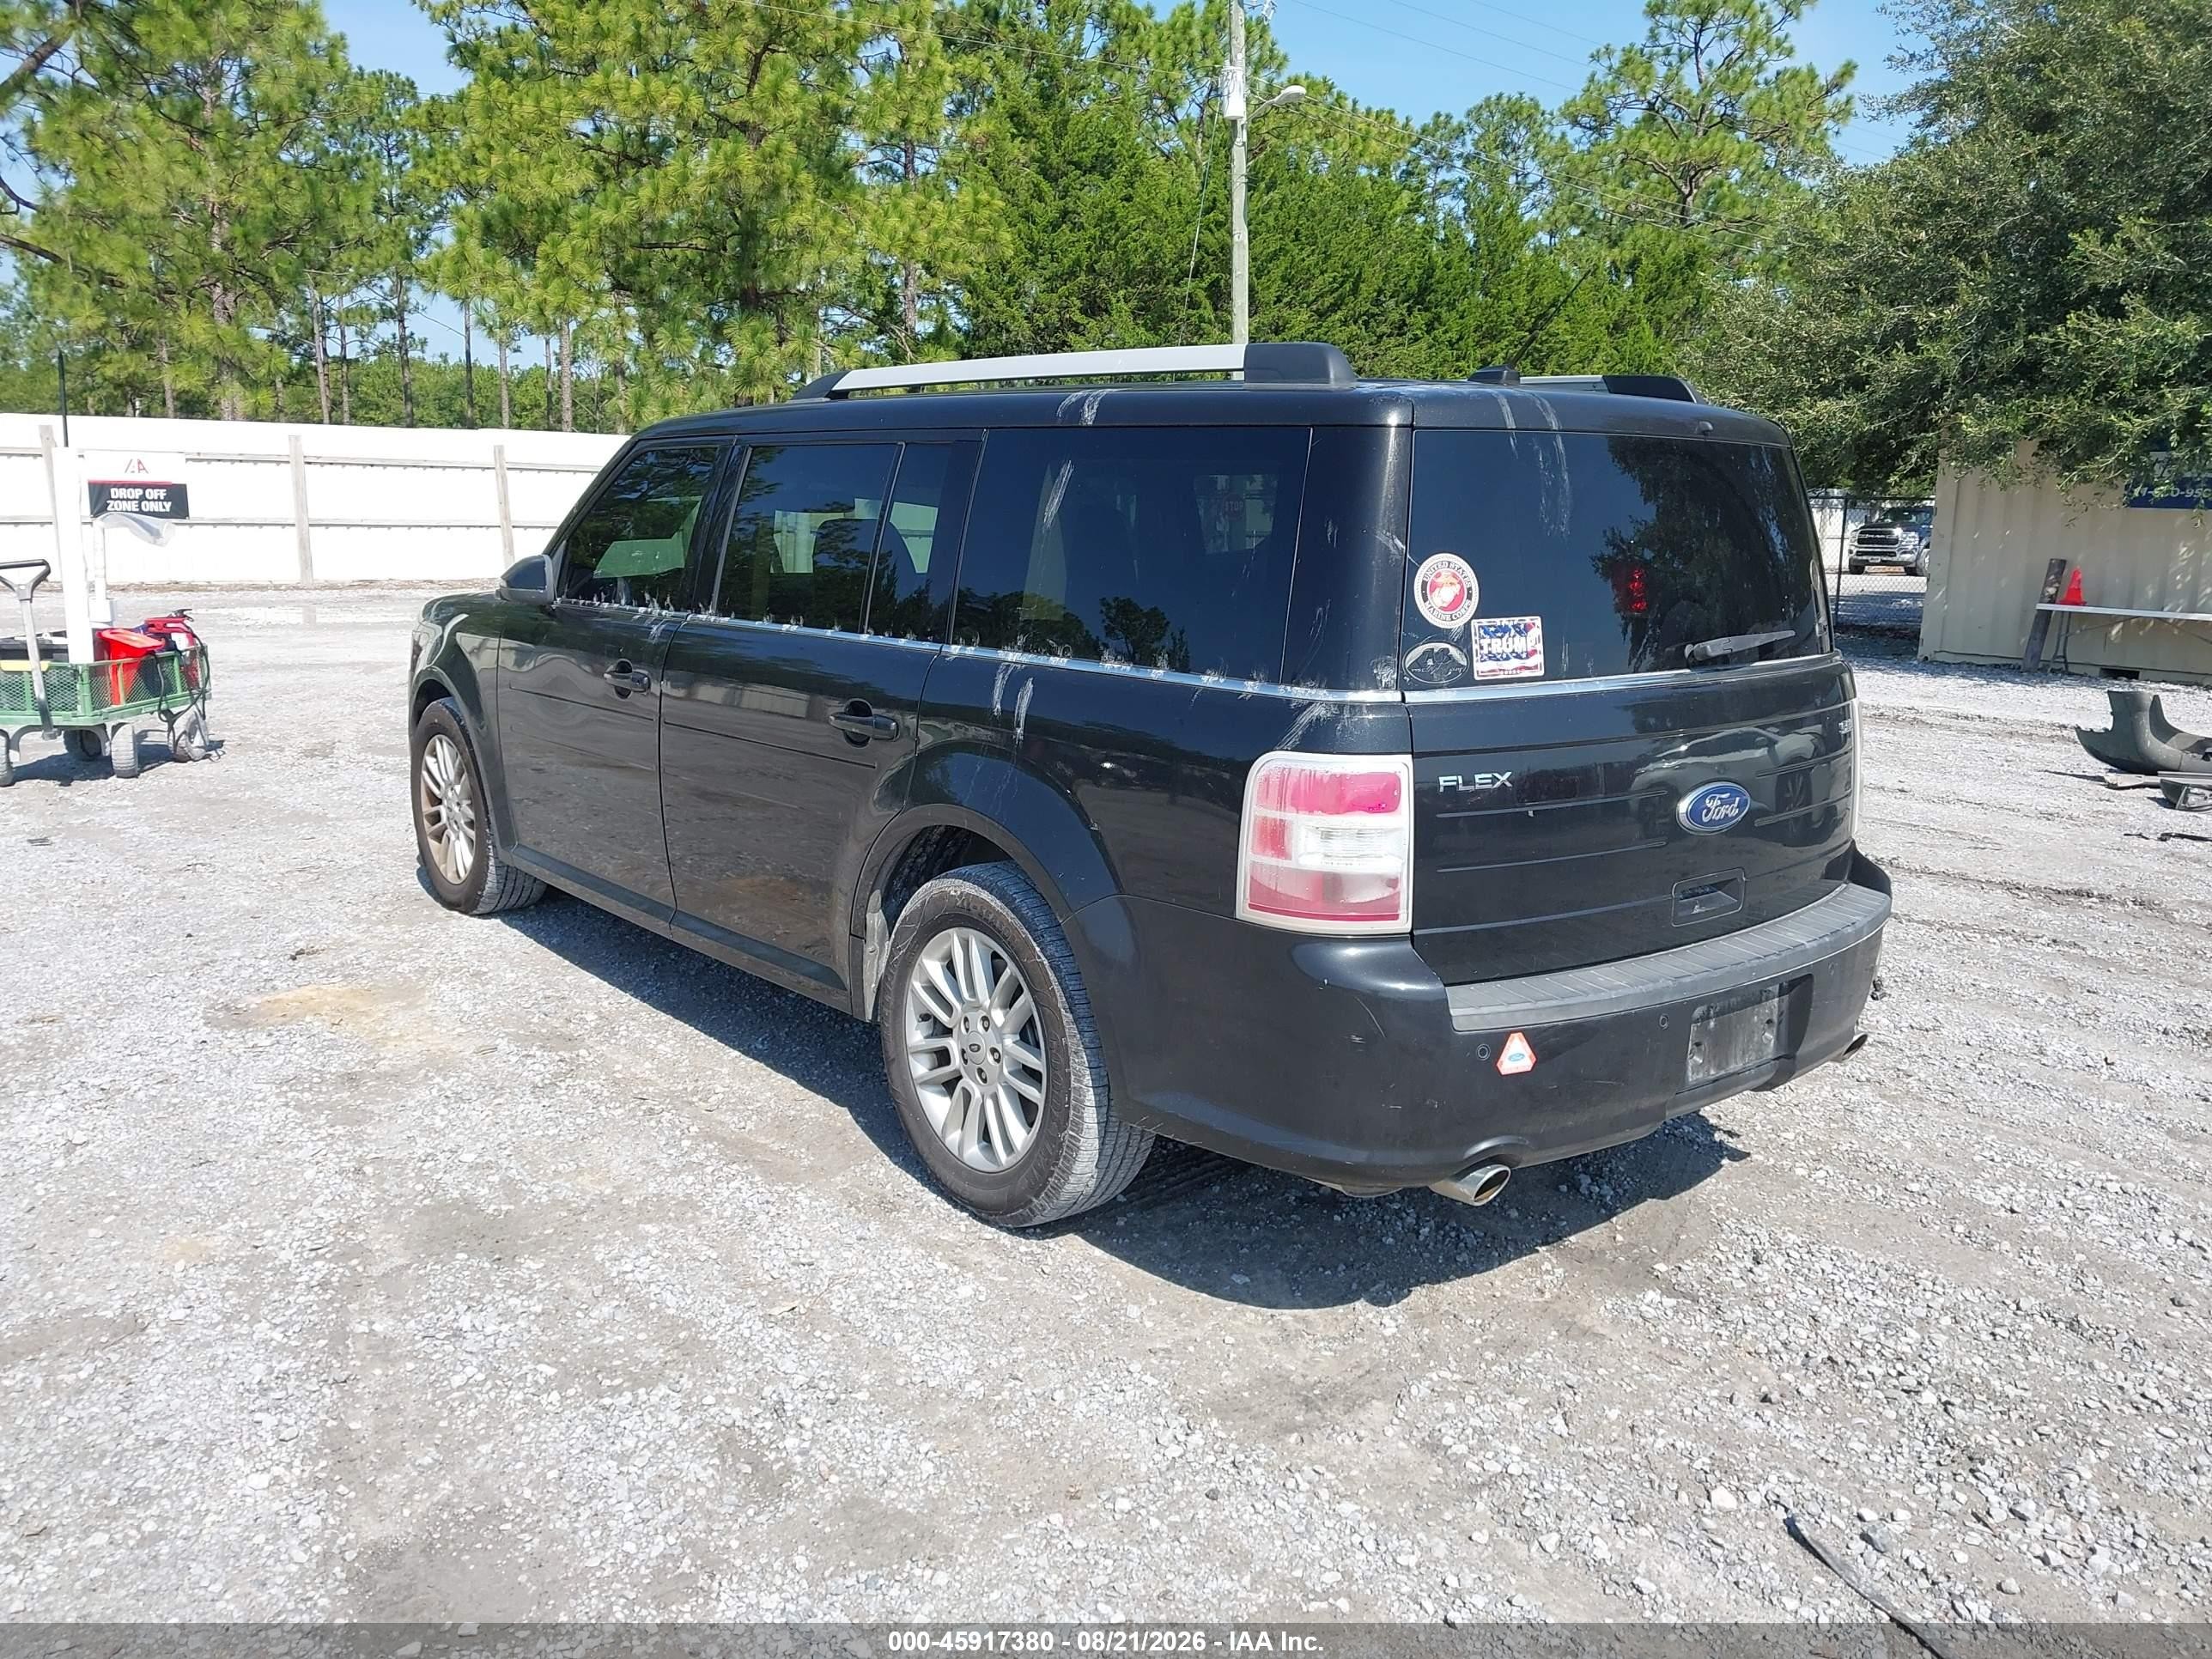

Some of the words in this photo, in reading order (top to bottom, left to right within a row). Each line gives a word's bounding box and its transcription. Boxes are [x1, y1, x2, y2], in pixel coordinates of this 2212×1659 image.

[110, 488, 143, 500] DROP
[145, 489, 167, 500] OFF
[106, 501, 139, 512] ZONE
[141, 501, 172, 513] ONLY
[1423, 561, 1449, 582] UNITED
[1449, 562, 1471, 588] STATES
[1425, 600, 1451, 621] MARINE
[1452, 599, 1472, 620] CORPS
[1479, 633, 1538, 654] TRUMP
[1438, 771, 1513, 793] FLEX
[1702, 793, 1741, 823] Ford
